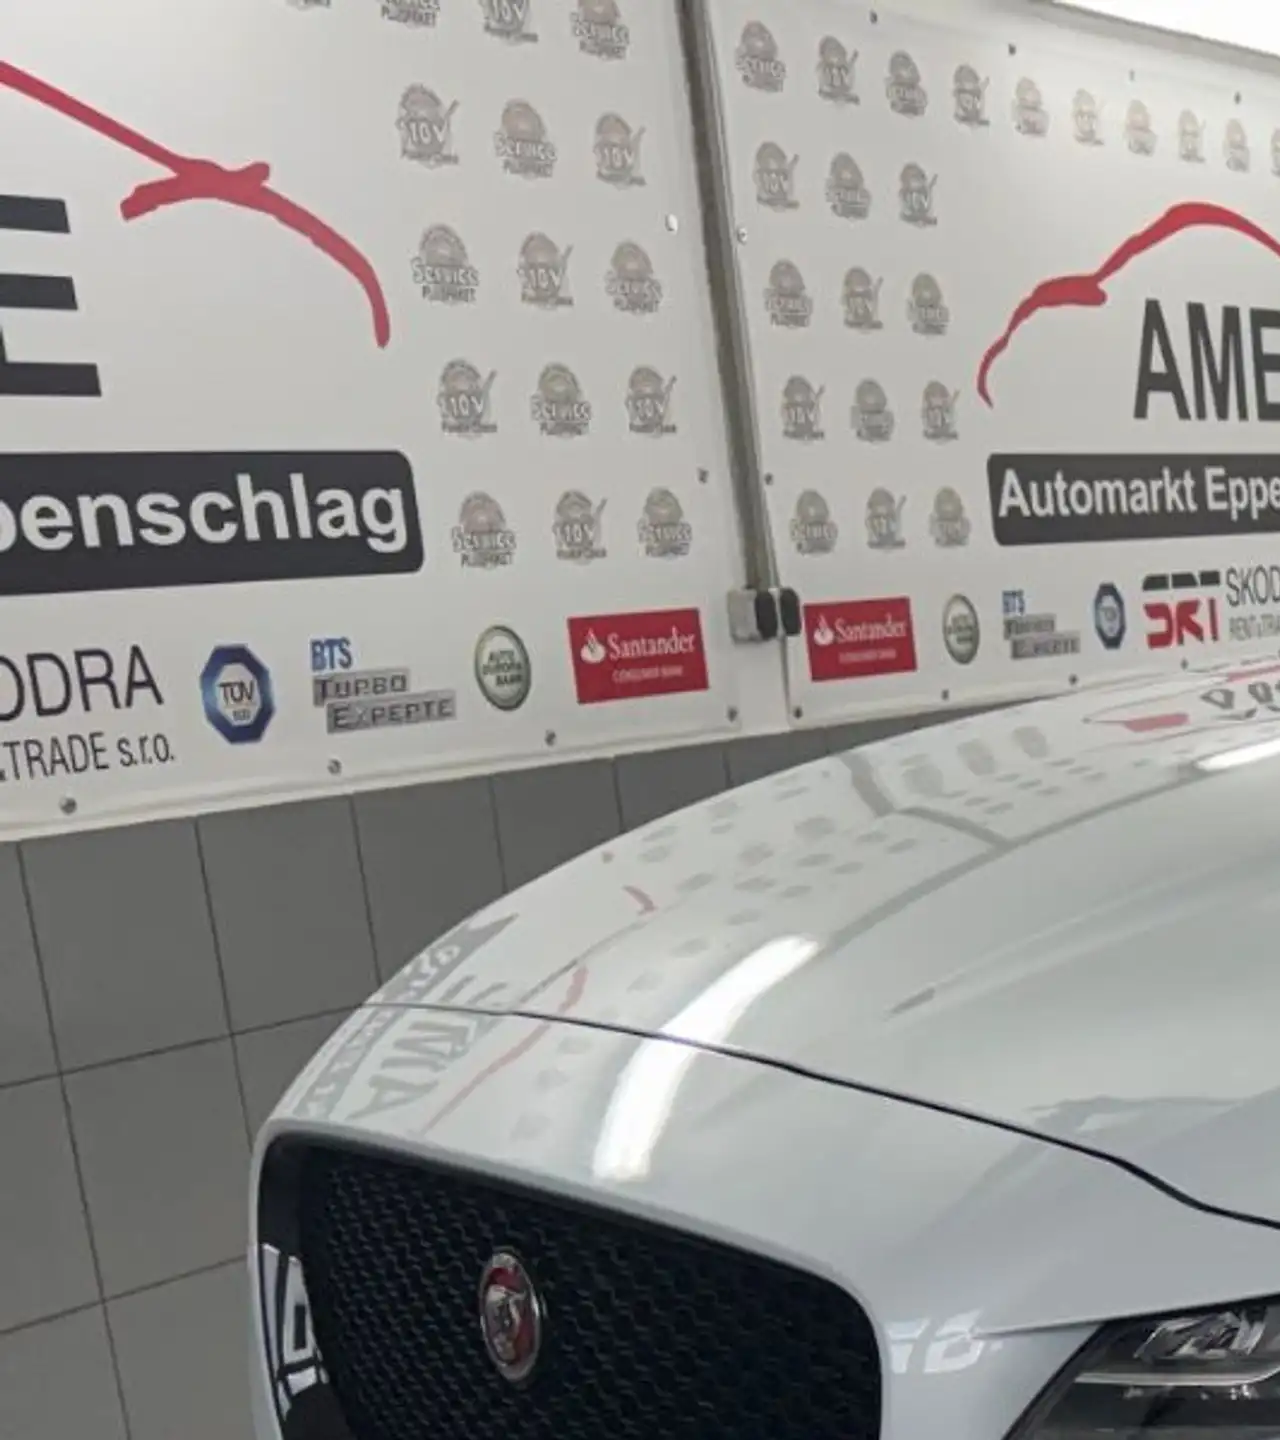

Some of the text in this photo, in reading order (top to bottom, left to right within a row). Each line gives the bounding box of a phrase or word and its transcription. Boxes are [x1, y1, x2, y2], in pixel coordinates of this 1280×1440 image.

[998, 466, 1198, 518] Automarkt
[607, 625, 696, 661] Santander
[833, 611, 908, 645] Santander
[310, 636, 353, 672] BTS
[116, 732, 176, 768] s.r.o.
